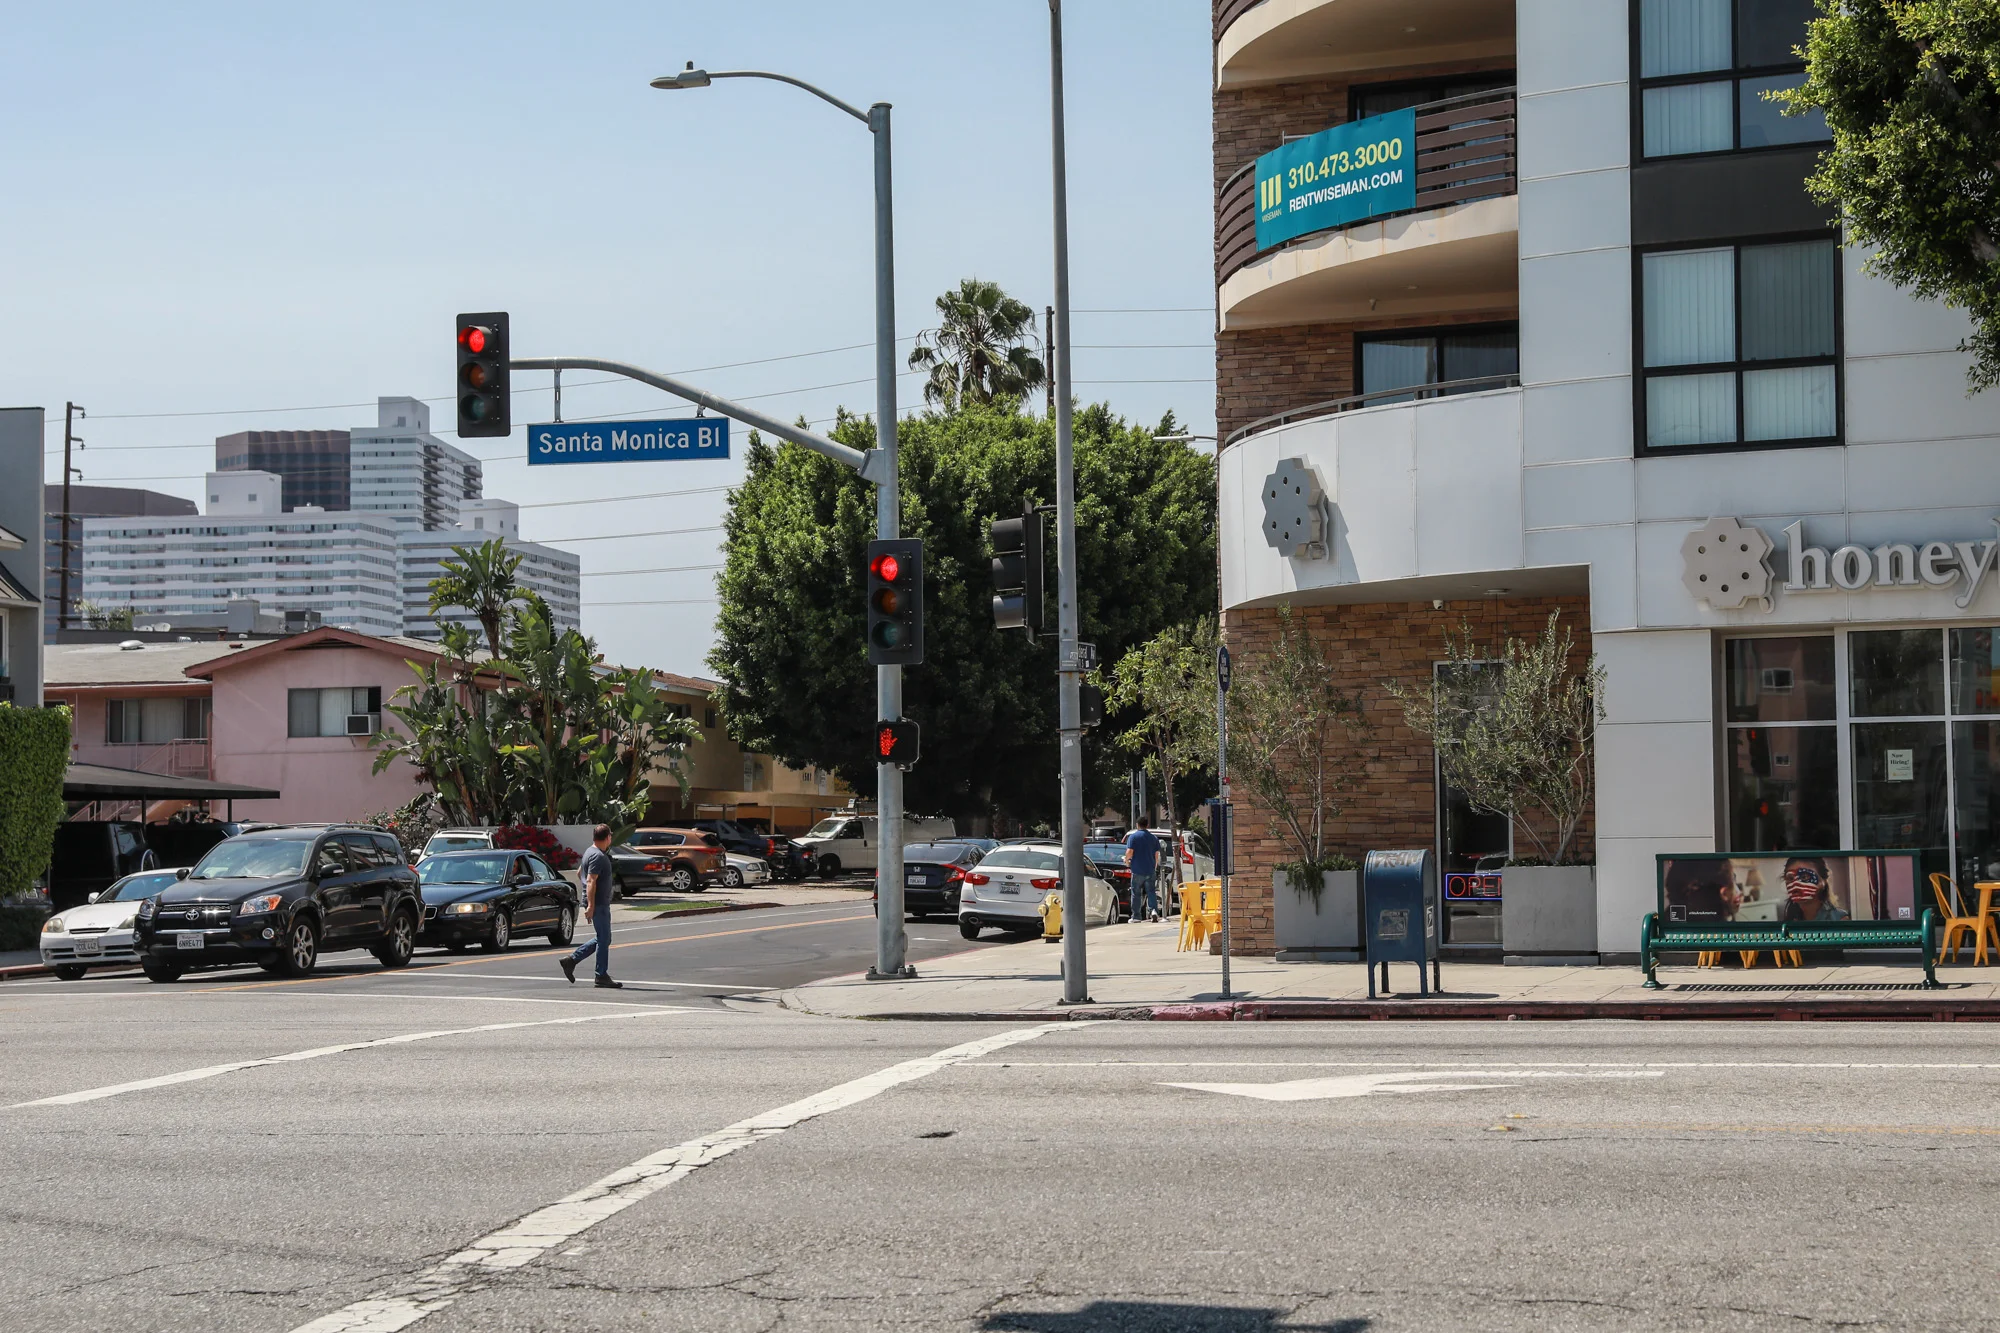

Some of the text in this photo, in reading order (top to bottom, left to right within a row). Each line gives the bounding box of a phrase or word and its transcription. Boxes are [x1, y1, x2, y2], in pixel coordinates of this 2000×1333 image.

[1288, 138, 1402, 189] 310.473.3000
[1289, 169, 1402, 213] RENTWISEMAN.COM
[1261, 208, 1282, 223] WISEMAN
[539, 426, 720, 453] Santa Monica Bl
[1782, 516, 2000, 609] honey
